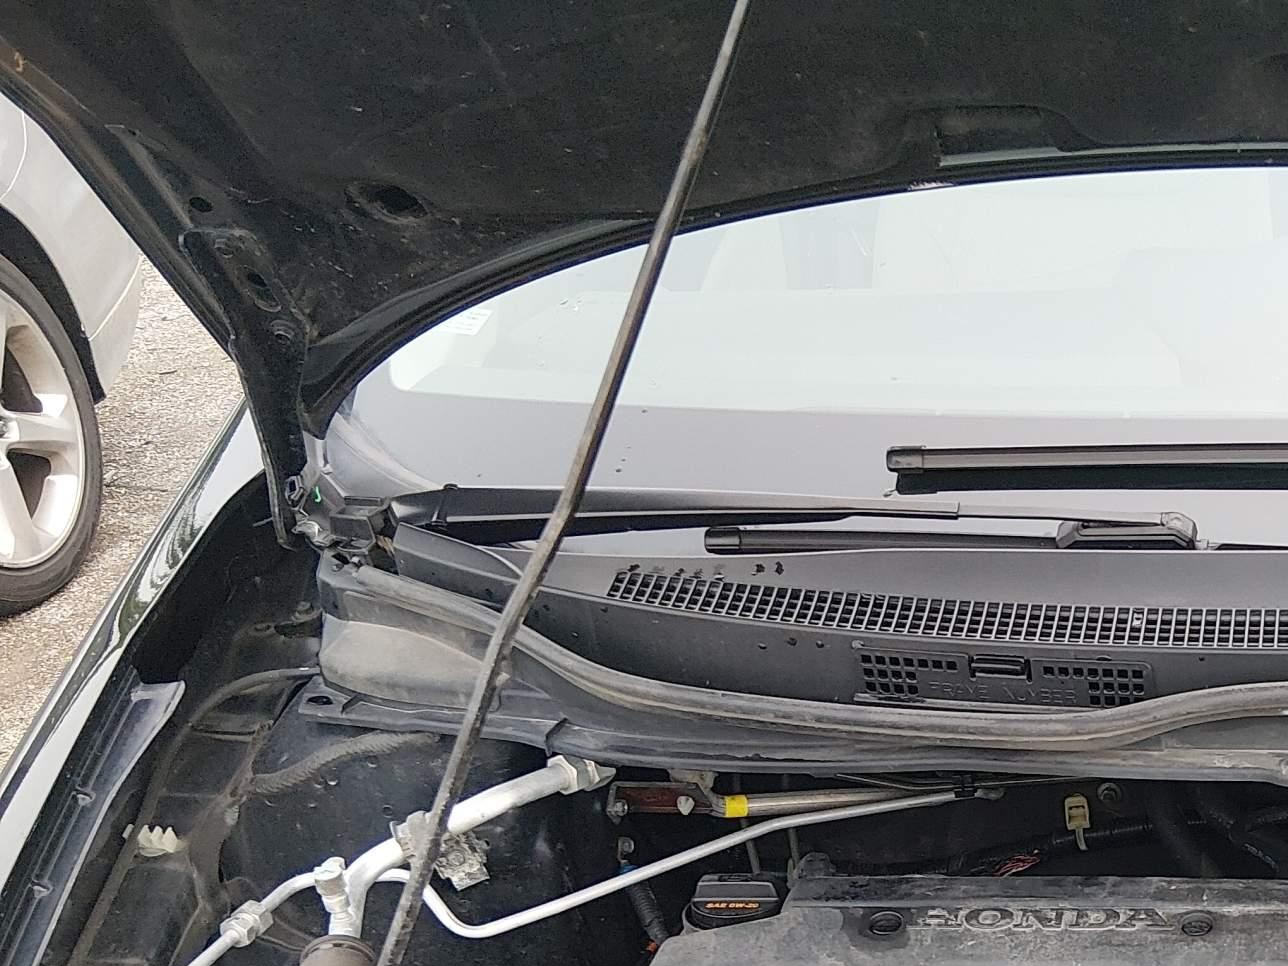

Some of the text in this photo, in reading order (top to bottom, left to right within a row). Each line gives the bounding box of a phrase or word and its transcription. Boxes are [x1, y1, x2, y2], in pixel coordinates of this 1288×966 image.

[928, 681, 1077, 704] FRAME NUMBER
[905, 906, 1176, 931] HONDA
